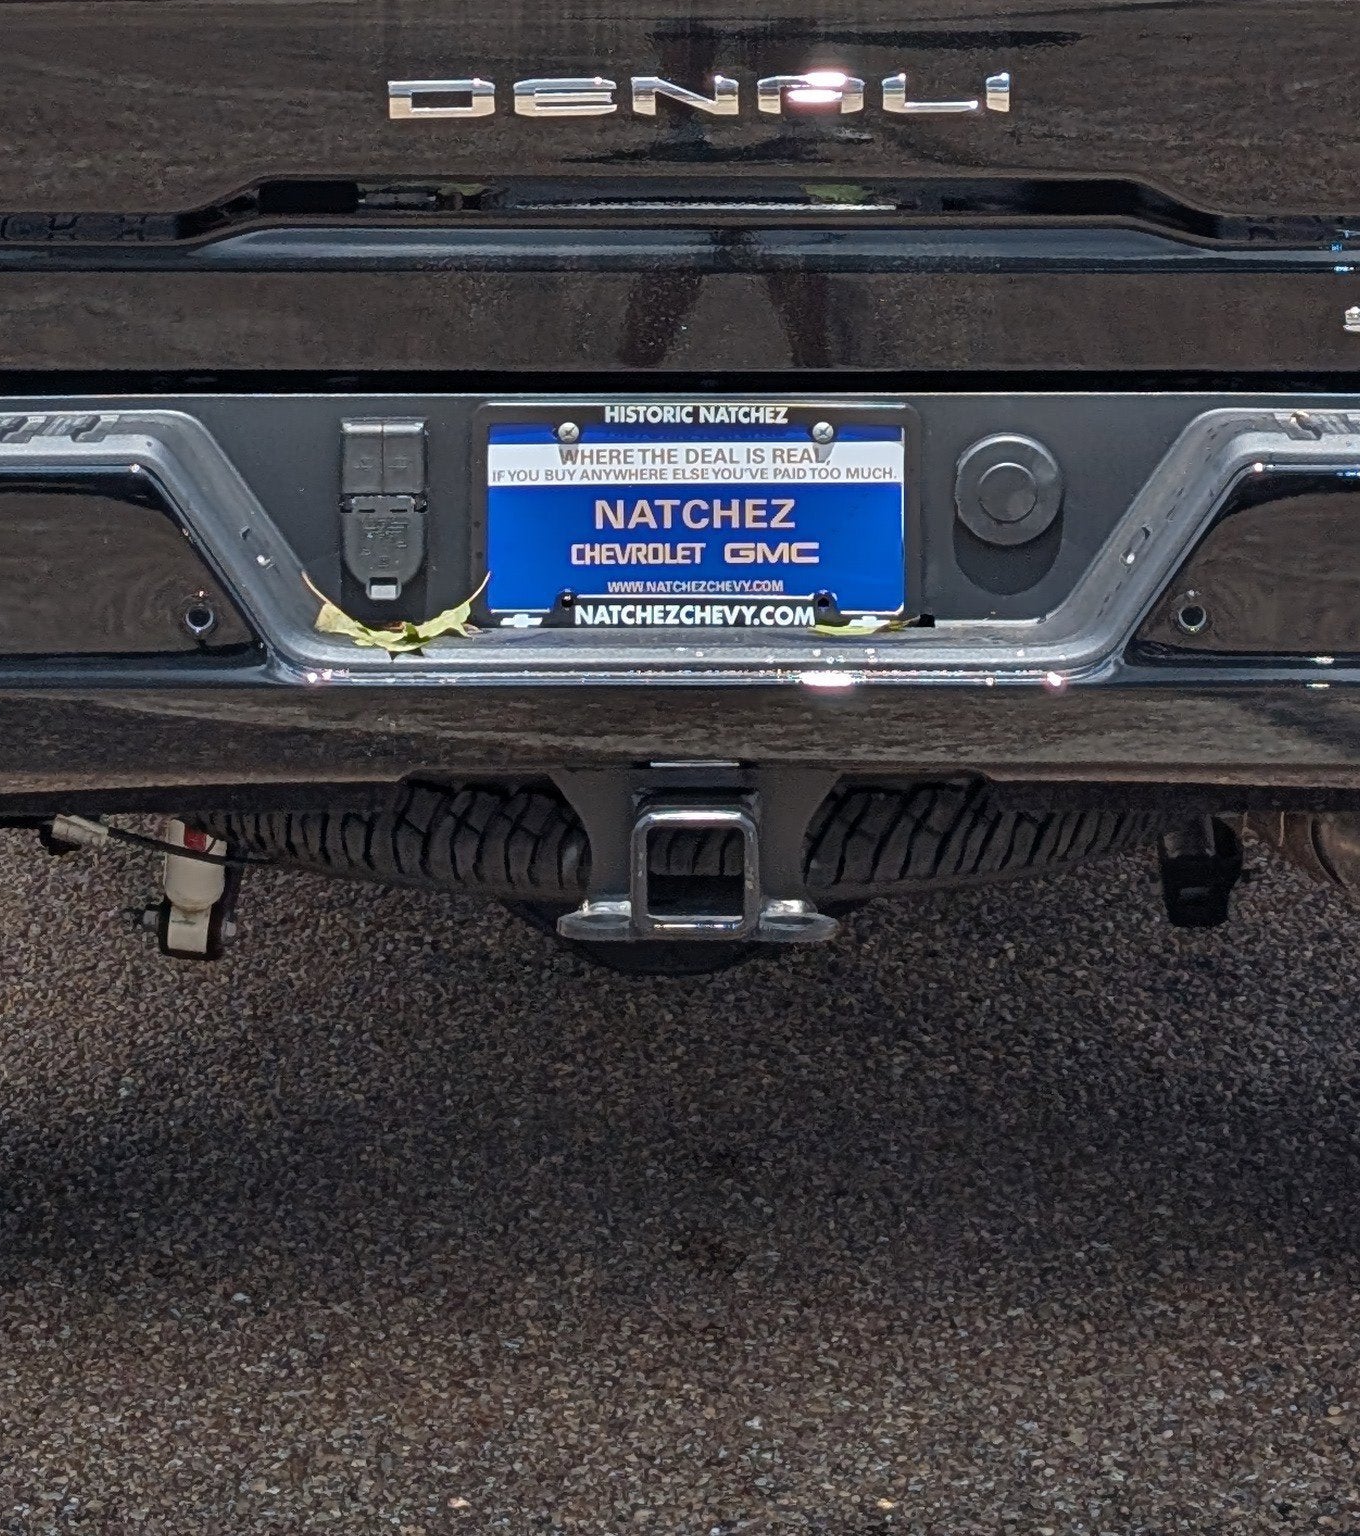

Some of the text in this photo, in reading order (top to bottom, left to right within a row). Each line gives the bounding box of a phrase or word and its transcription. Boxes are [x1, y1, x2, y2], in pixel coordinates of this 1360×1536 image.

[388, 73, 1010, 119] DENALI
[604, 405, 789, 424] HISTORIC NATCHEZ
[559, 448, 634, 465] WHERE
[637, 448, 677, 465] THE
[685, 448, 739, 464] DEAL
[746, 448, 765, 464] IS
[492, 467, 897, 482] IF YOU BUY ANYWHERE ELSE YOU'VE PAID TOO MUCH.
[595, 499, 795, 530] NATCHEZ
[571, 542, 819, 565] CHEVROLET GMC
[607, 580, 784, 593] WWW.NATCHEZCHEVY.COM
[574, 605, 815, 626] NATCHEZCHEVY.COM
